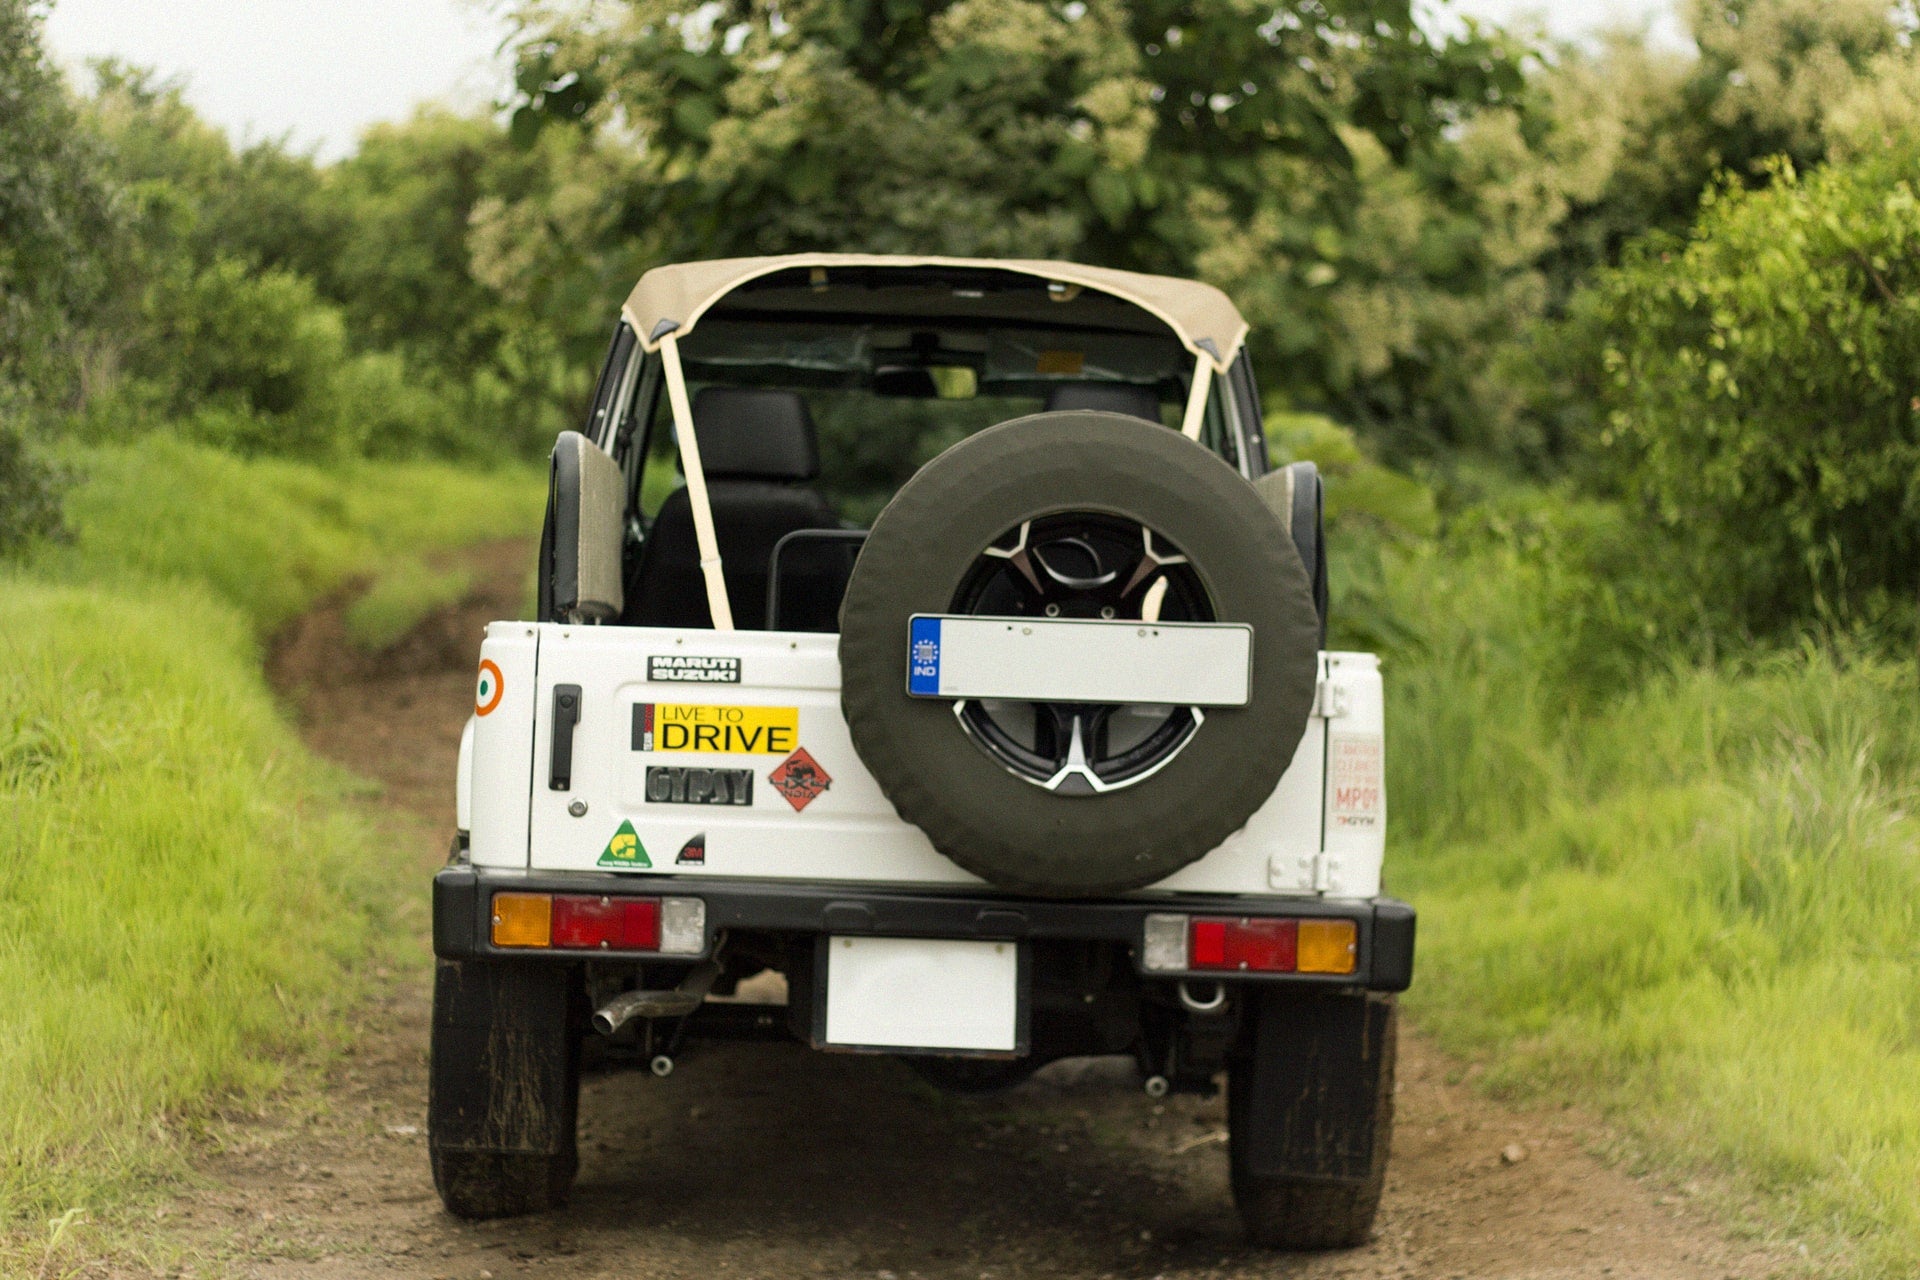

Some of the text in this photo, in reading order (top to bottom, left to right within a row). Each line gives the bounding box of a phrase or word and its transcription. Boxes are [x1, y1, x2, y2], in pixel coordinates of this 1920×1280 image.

[652, 657, 736, 669] MARUTI
[652, 669, 736, 682] SUZUKI
[914, 666, 936, 677] IND
[663, 705, 744, 723] LIVE TO
[662, 723, 792, 753] DRIVE
[647, 767, 752, 805] GYPSY
[684, 847, 703, 858] 3M
